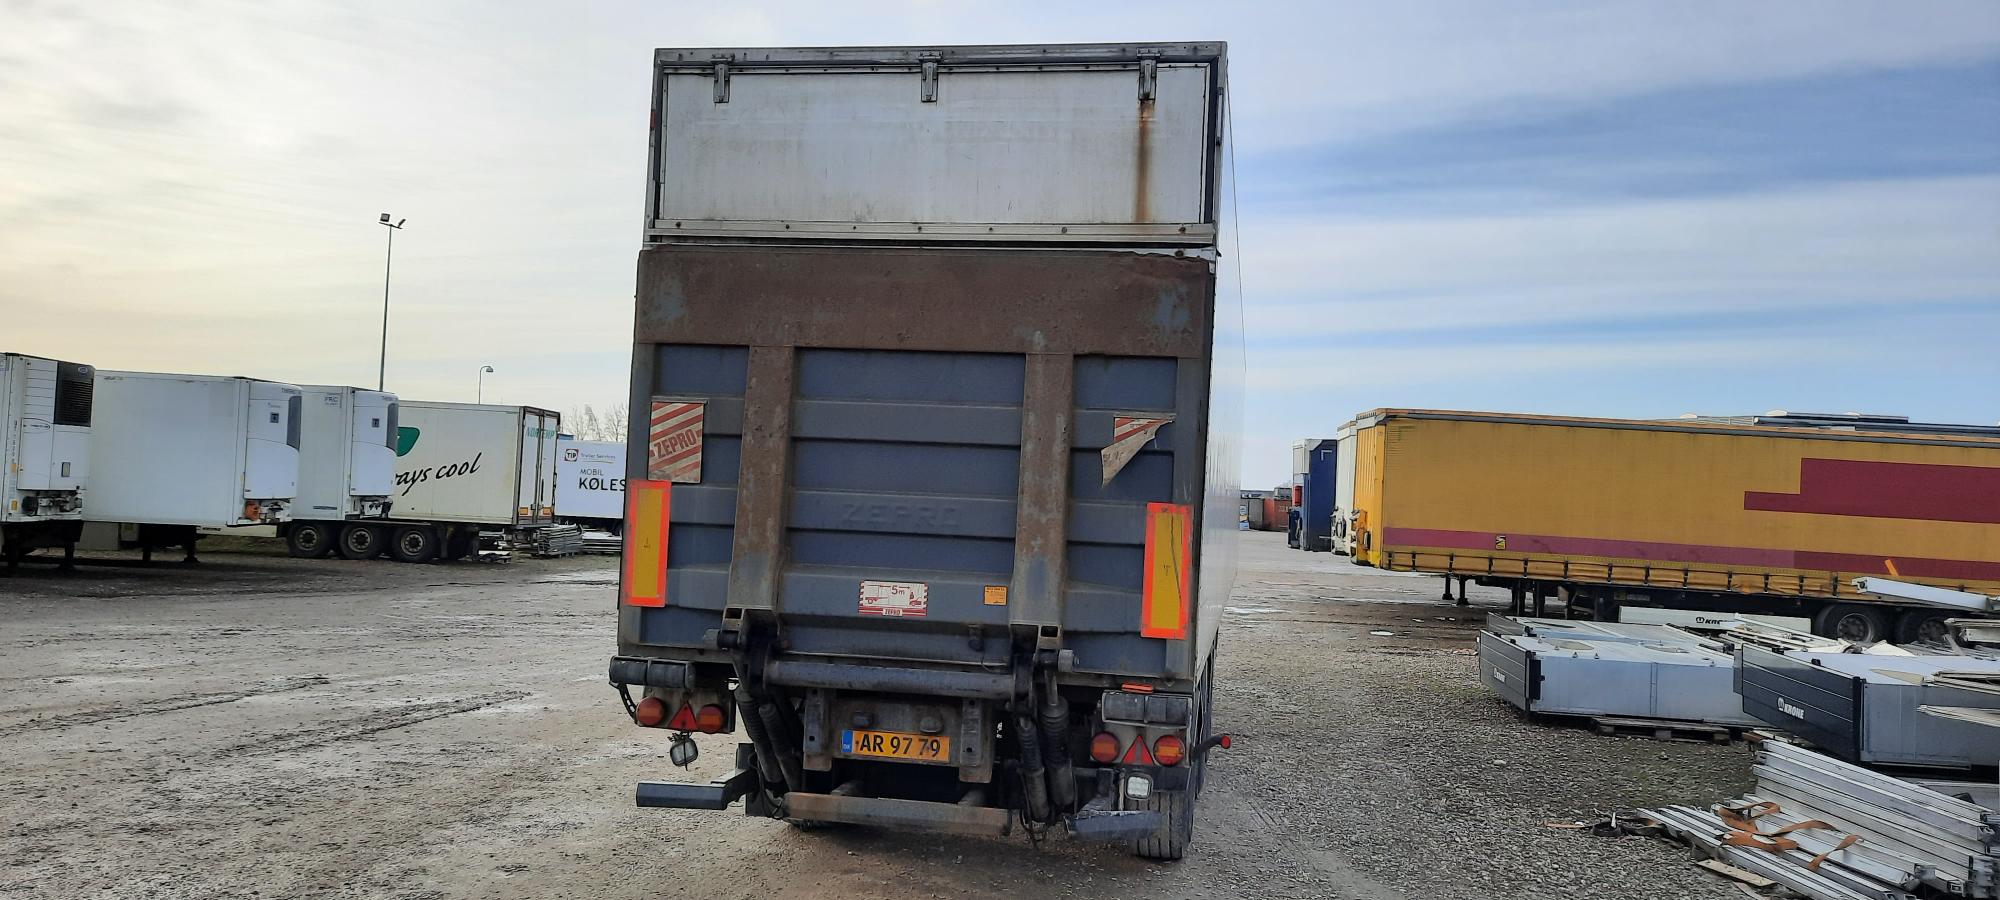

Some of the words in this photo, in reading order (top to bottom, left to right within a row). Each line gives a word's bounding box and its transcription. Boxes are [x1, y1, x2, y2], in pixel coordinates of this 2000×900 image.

[654, 429, 697, 459] ZEPRO
[395, 467, 432, 496] ays
[436, 452, 482, 479] cool
[580, 468, 604, 476] MOBIL
[1783, 703, 1805, 720] KRONE
[860, 733, 885, 753] AR
[890, 736, 912, 755] 97
[919, 738, 941, 757] 79
